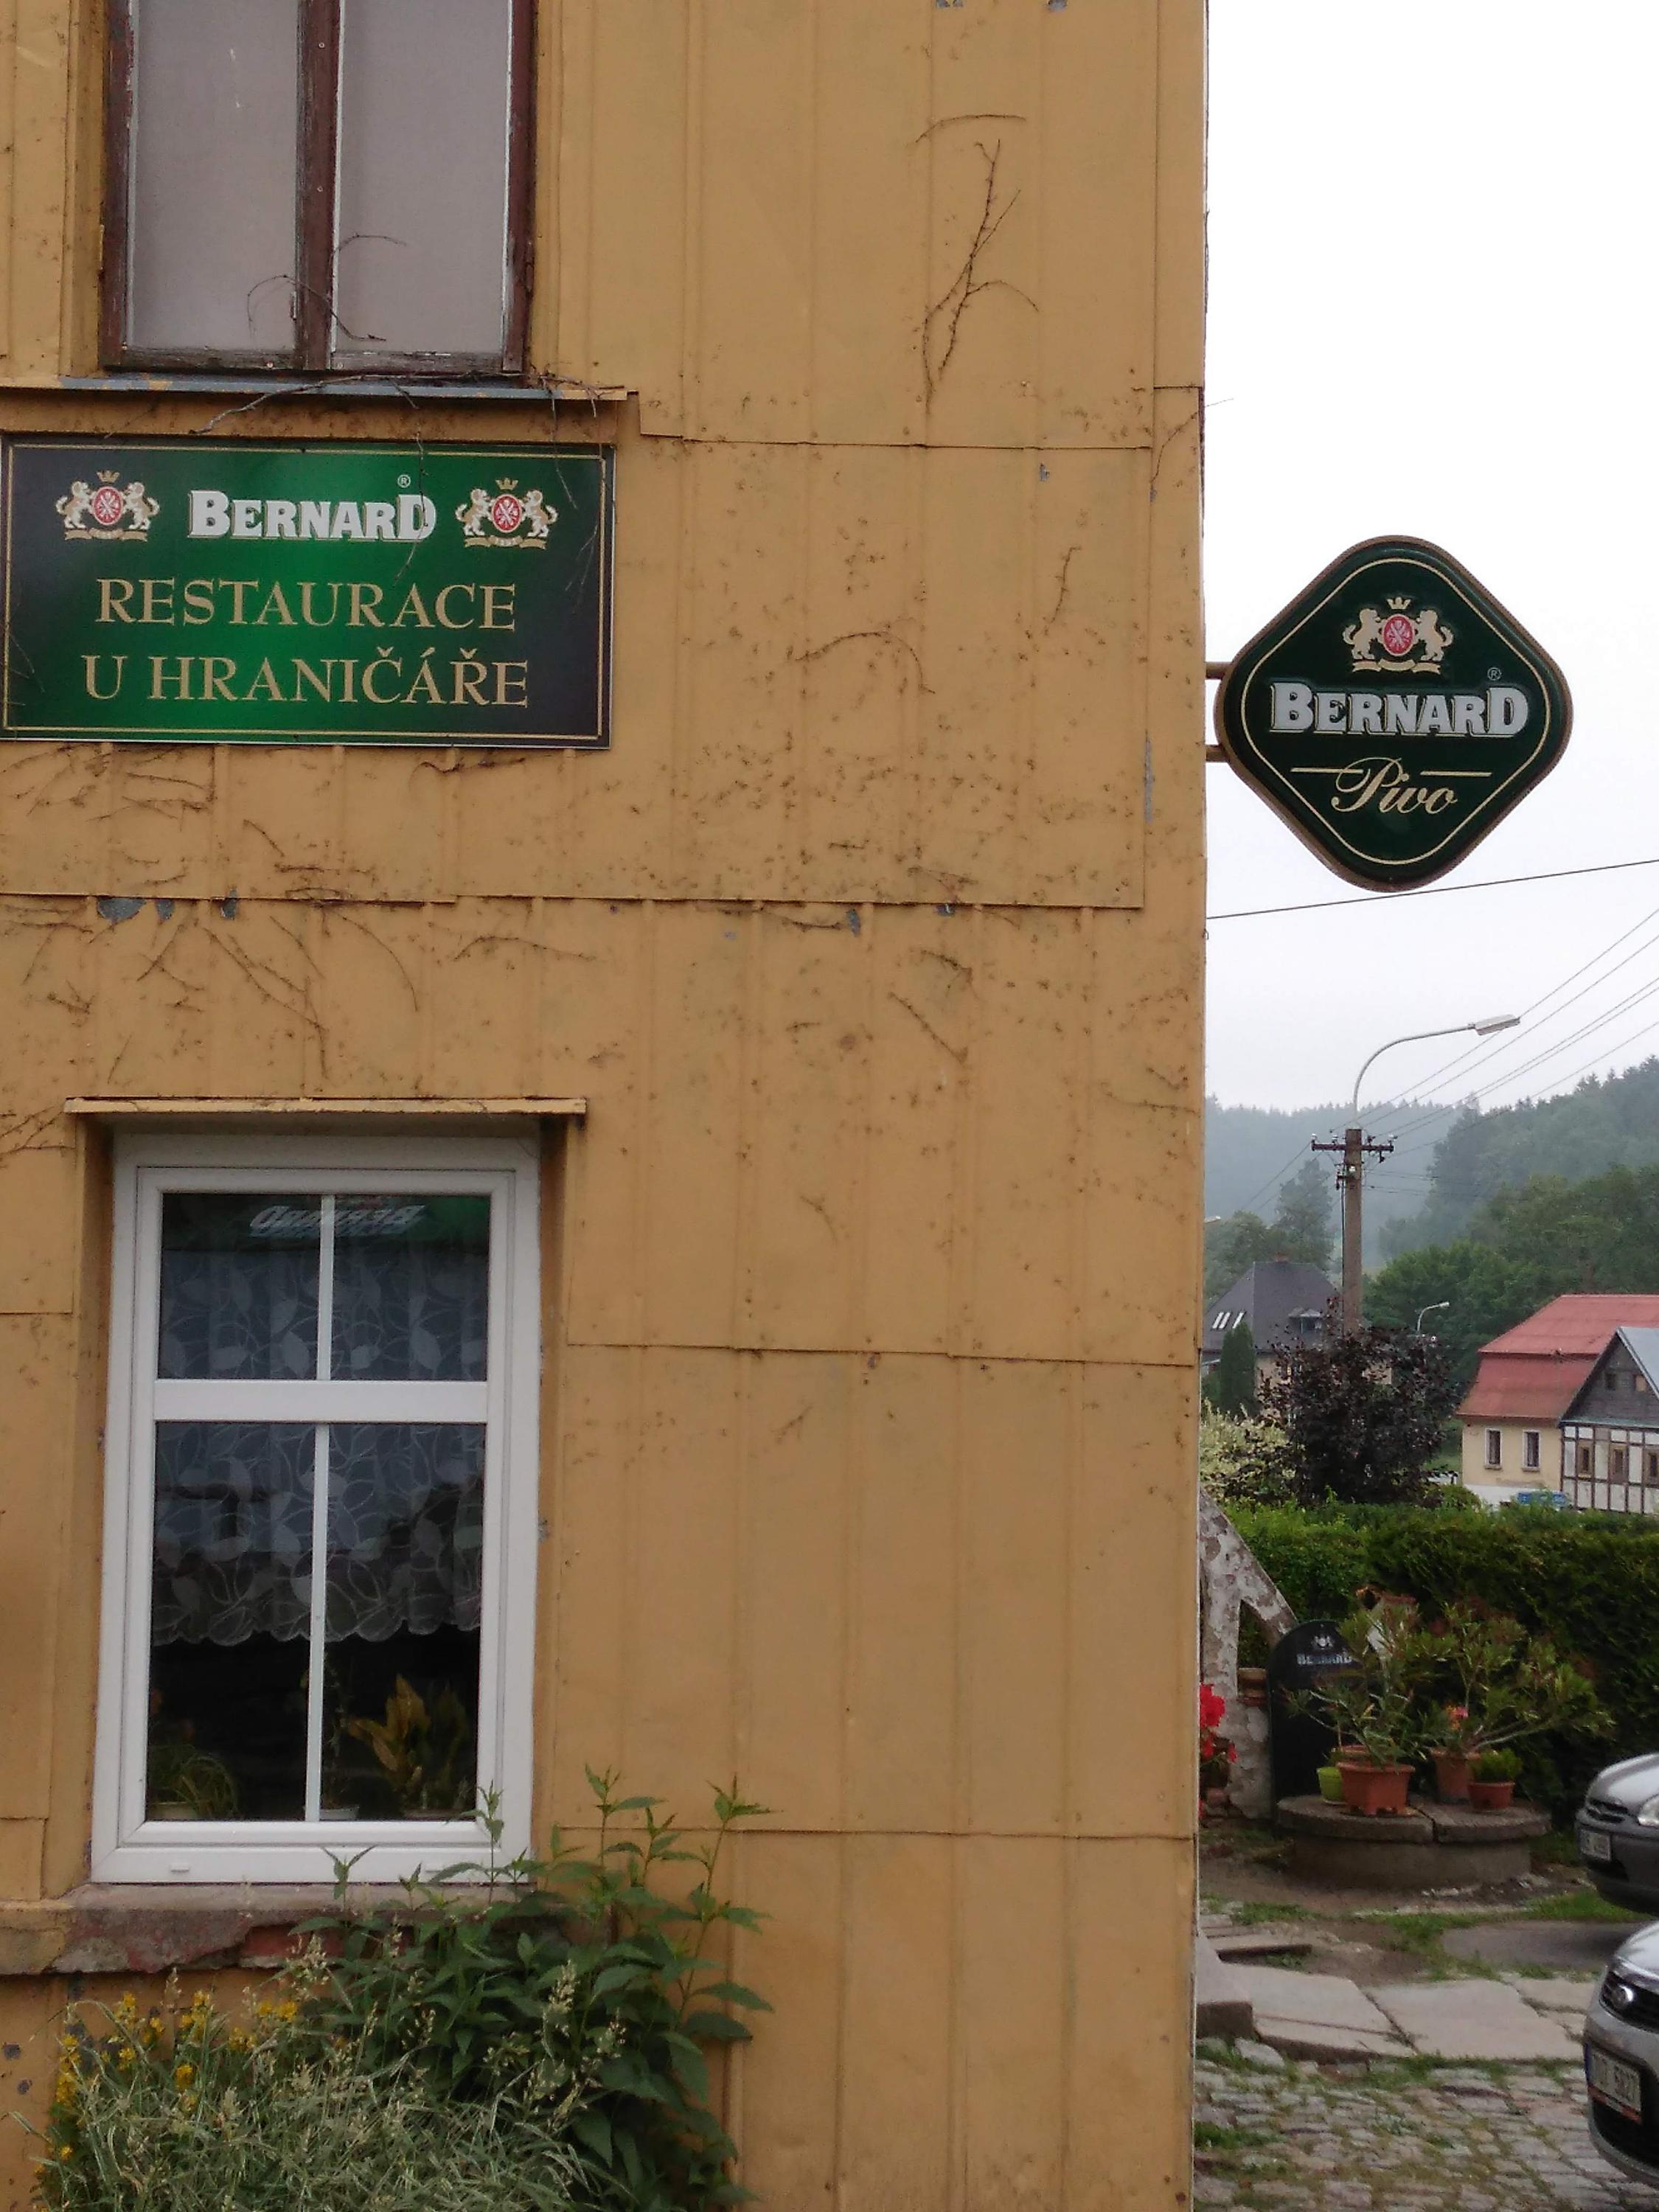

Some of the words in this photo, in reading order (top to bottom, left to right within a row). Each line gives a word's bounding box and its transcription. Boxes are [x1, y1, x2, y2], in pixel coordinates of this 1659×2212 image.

[187, 490, 437, 542] BERNARD
[96, 577, 517, 633] RESTAURACE
[82, 655, 128, 701] U
[148, 646, 529, 709] HRANIČÁŘE
[1270, 682, 1529, 738] BERNARD
[1331, 757, 1458, 815] Pivo
